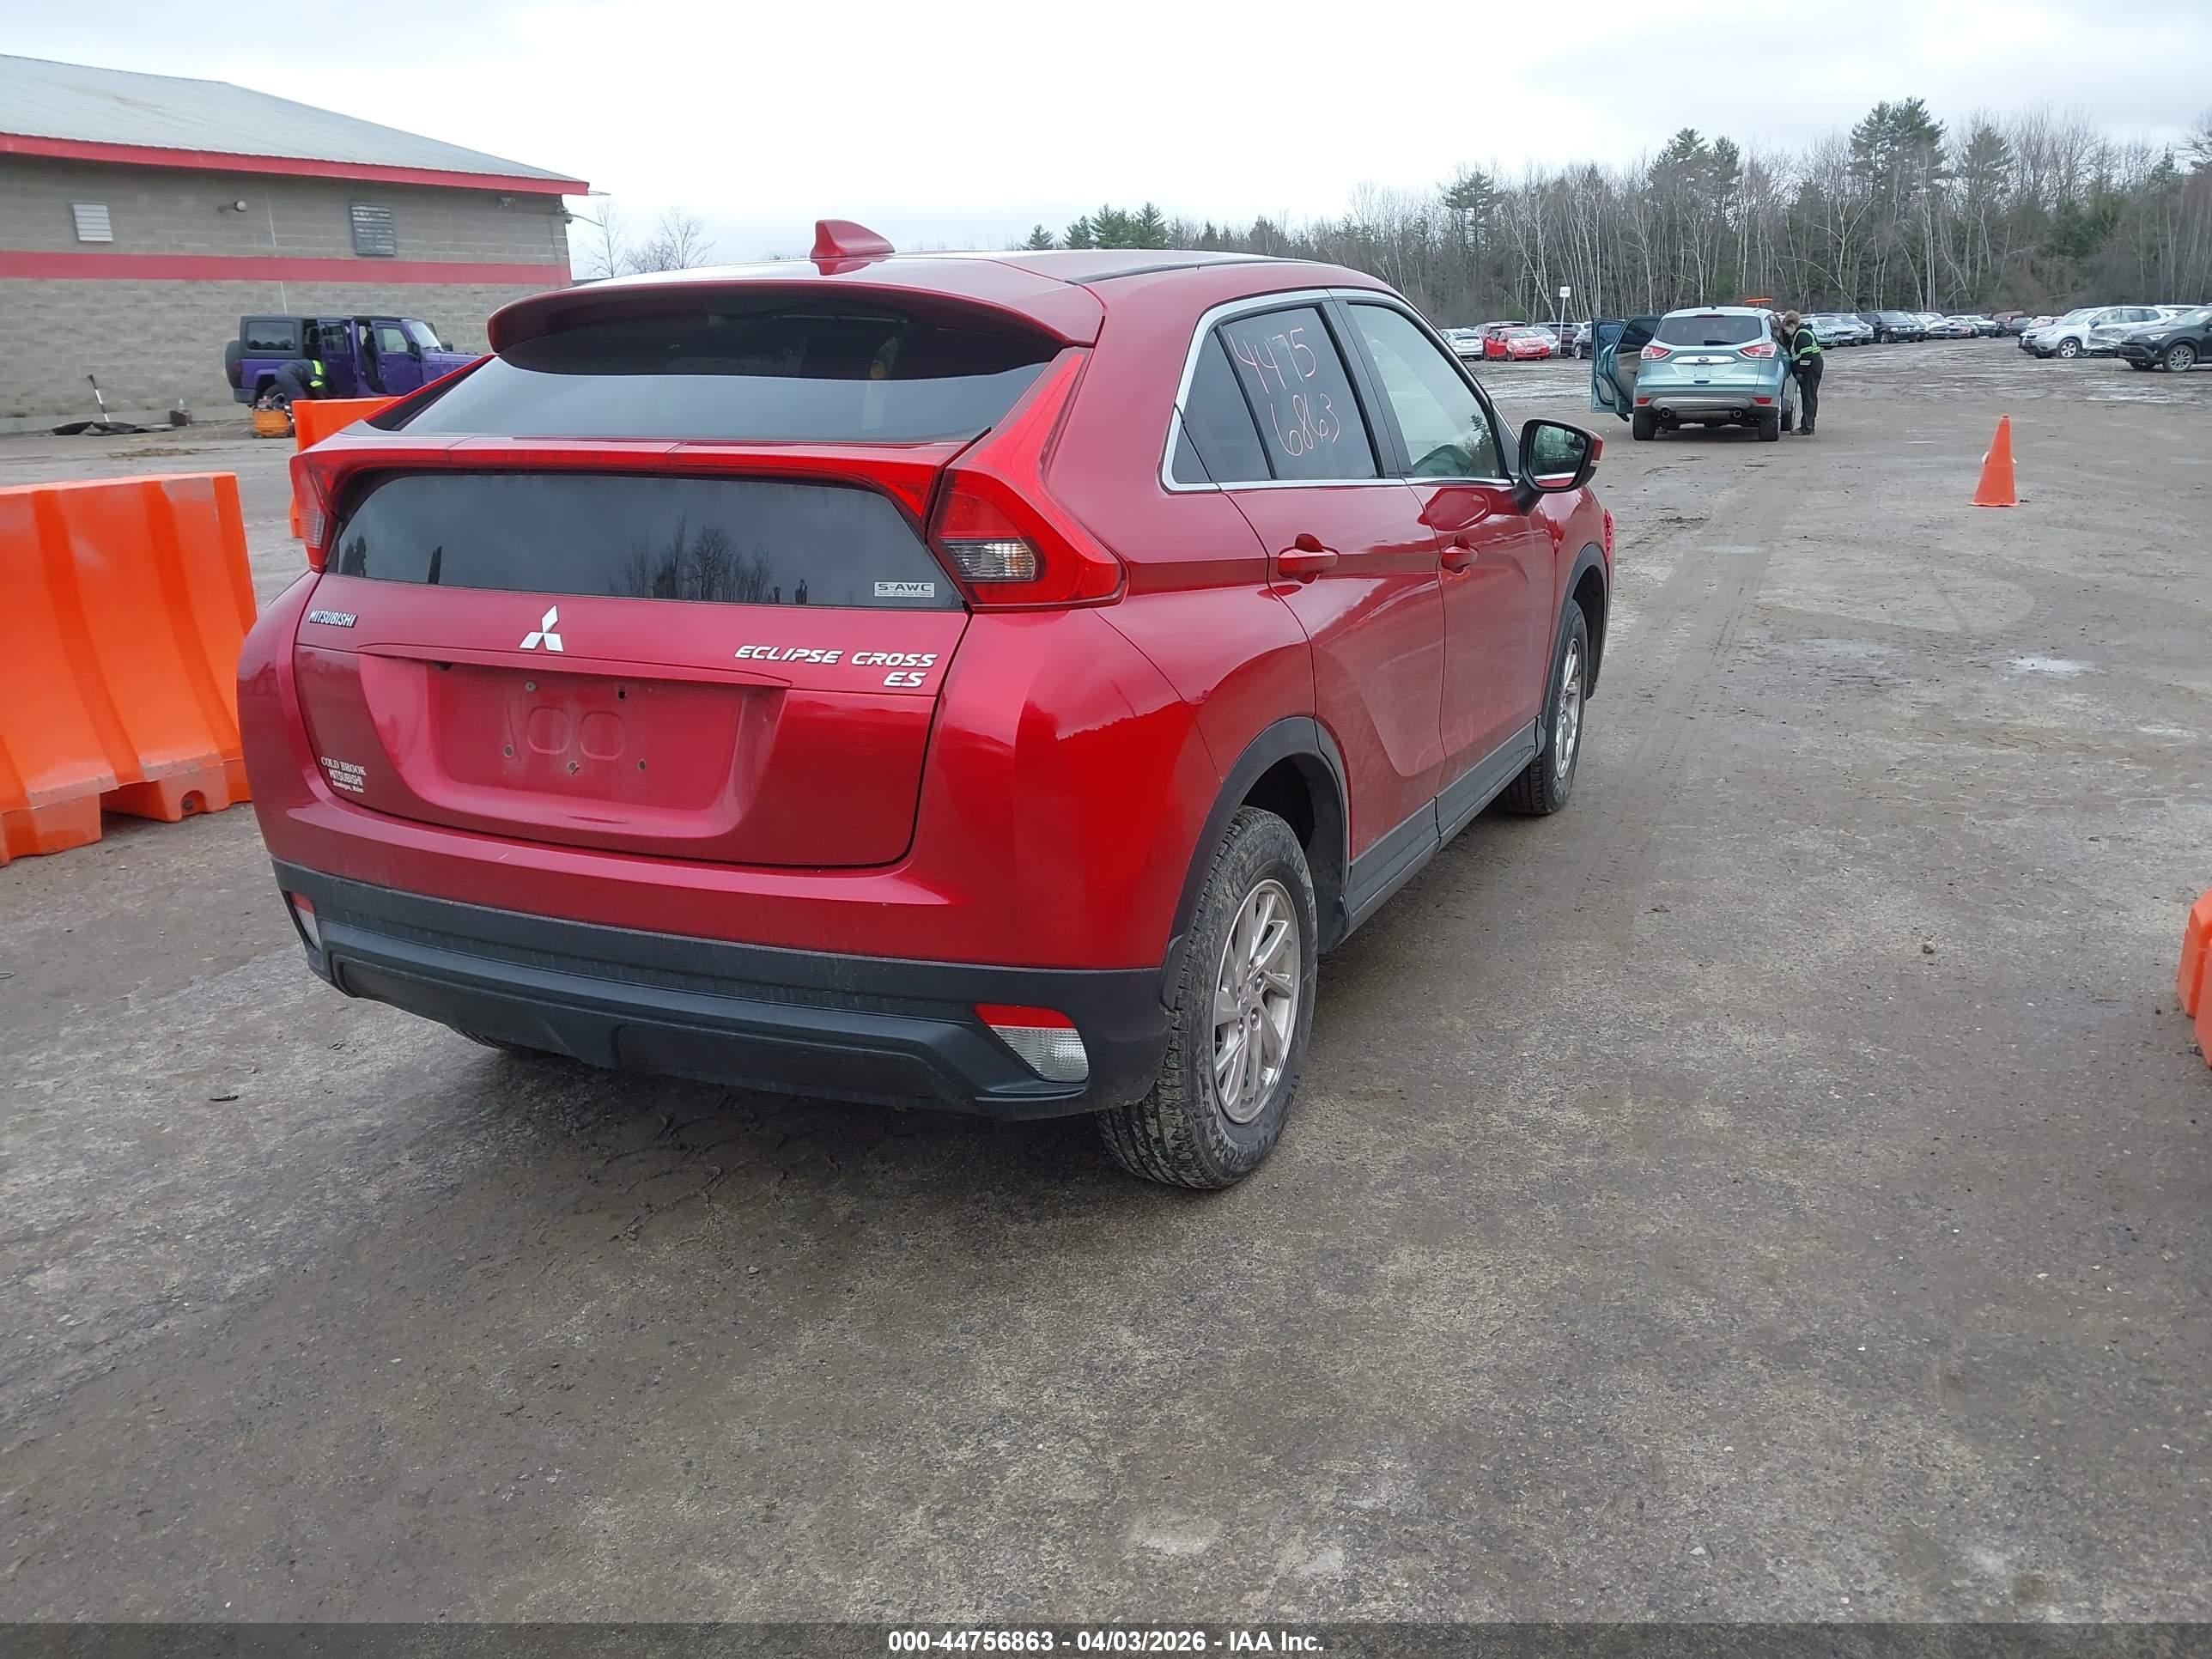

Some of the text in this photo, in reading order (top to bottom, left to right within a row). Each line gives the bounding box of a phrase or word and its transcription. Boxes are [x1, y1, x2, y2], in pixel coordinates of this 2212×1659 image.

[1228, 327, 1317, 394] 4475
[1270, 392, 1341, 457] 6863
[878, 583, 932, 592] S-AWC
[308, 610, 357, 628] MITSUBISHI
[735, 645, 939, 668] ECLIPSE CROSS
[883, 672, 927, 688] ES
[320, 756, 367, 776] COLD BROOK
[328, 768, 363, 786] MITSUBISHI
